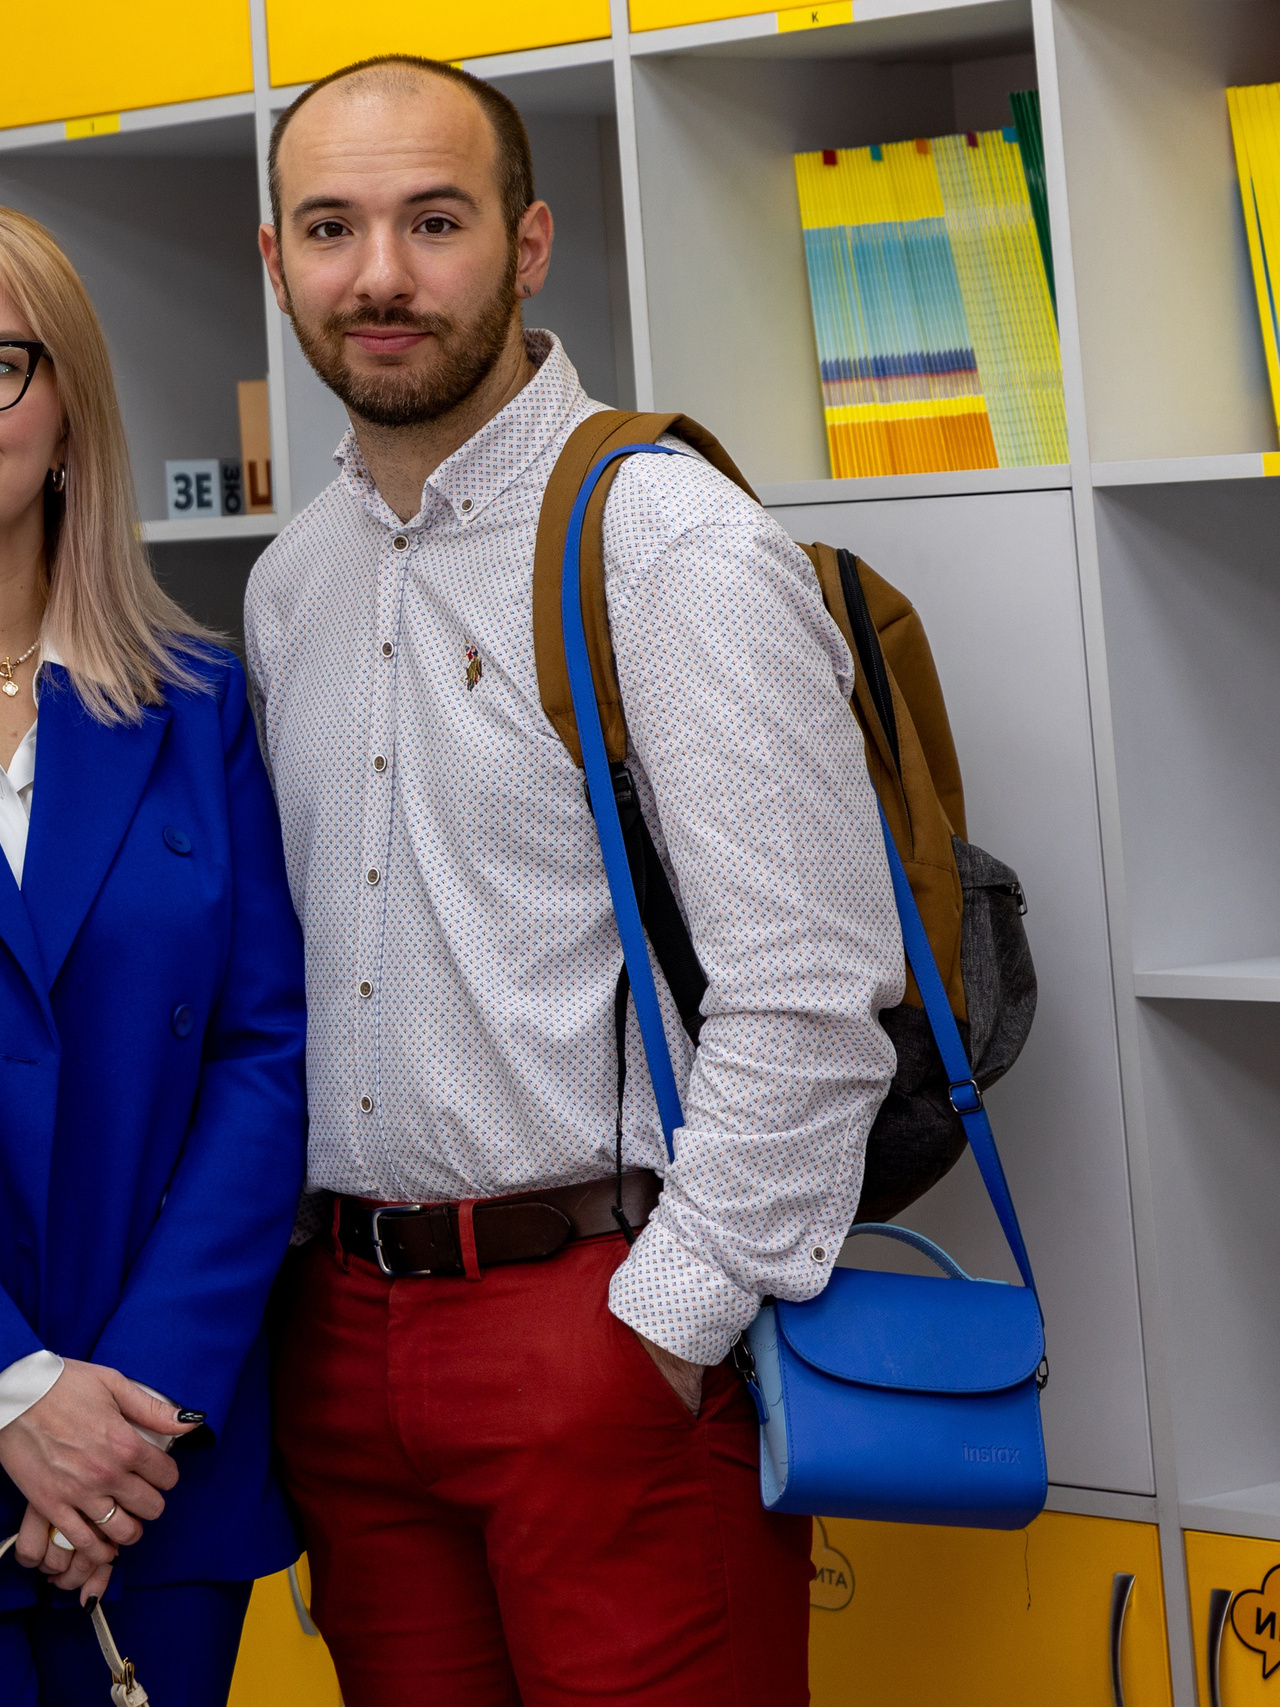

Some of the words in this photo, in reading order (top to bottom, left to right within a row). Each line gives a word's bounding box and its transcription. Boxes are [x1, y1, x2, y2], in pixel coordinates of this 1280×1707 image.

[811, 11, 819, 23] K
[962, 1440, 1020, 1464] instax
[1255, 1606, 1280, 1642] И
